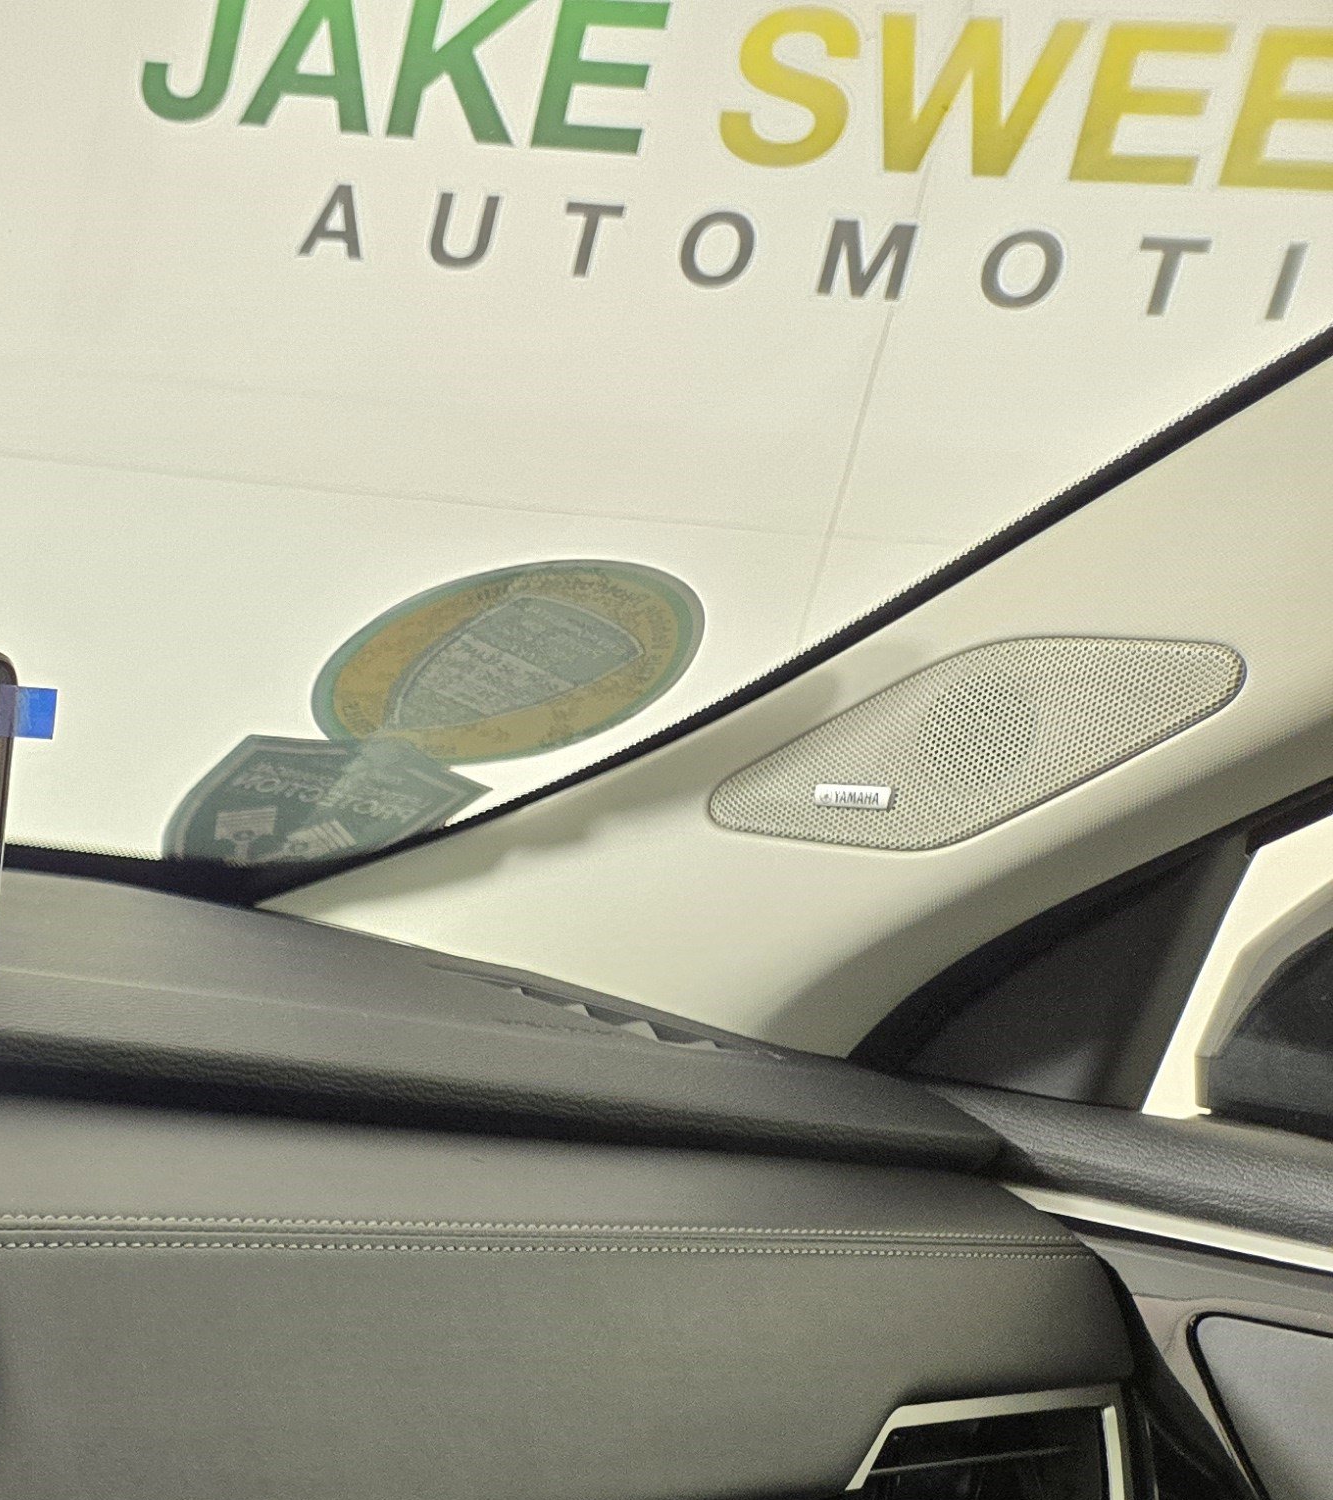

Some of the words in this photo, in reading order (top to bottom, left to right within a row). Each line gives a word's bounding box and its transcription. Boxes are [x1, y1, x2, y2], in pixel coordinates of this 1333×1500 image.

[141, 0, 673, 156] JAKE
[298, 183, 1311, 323] AUTOMOTI
[835, 790, 879, 806] YAMAHA
